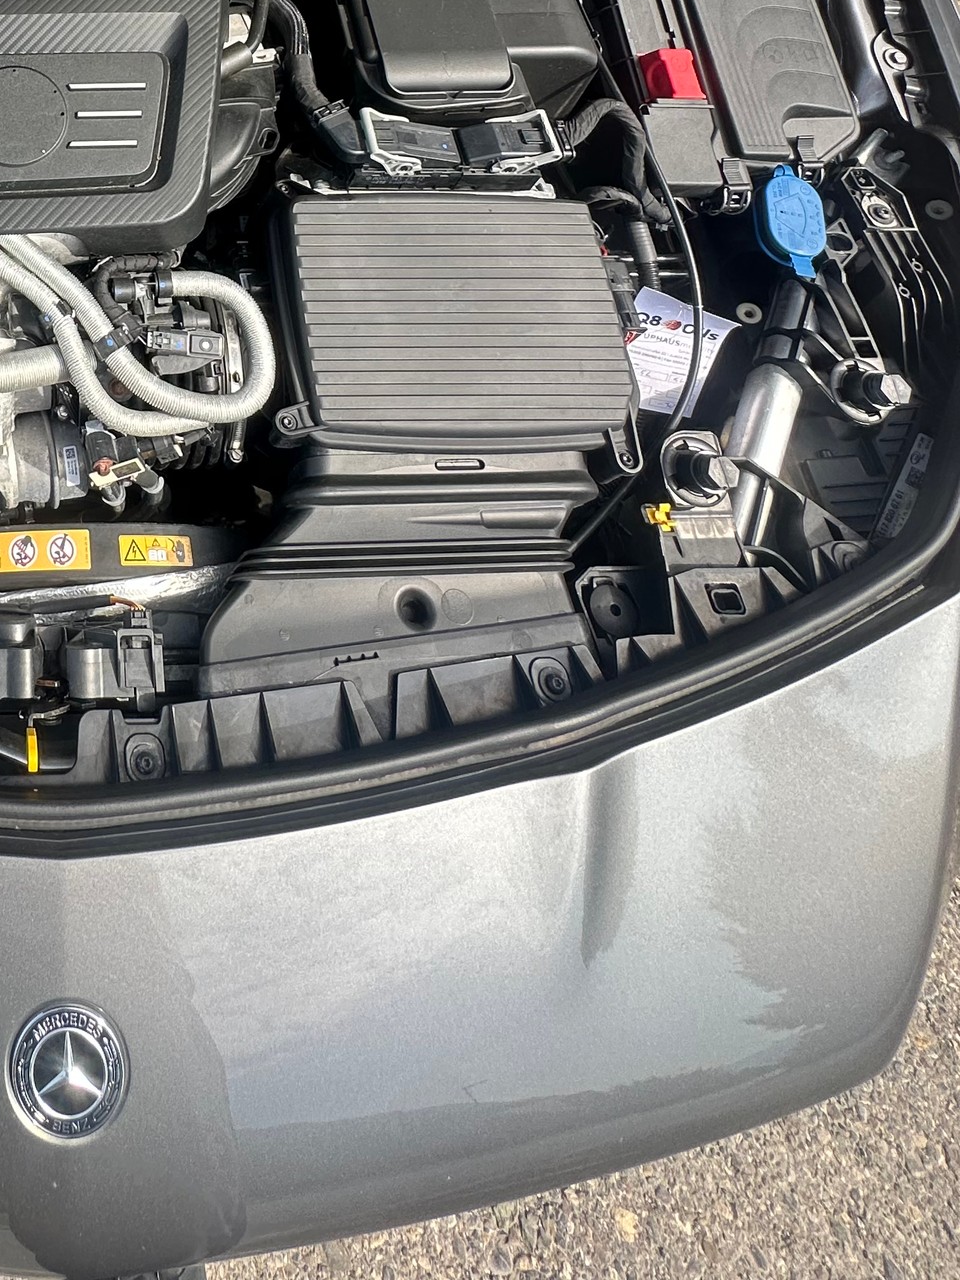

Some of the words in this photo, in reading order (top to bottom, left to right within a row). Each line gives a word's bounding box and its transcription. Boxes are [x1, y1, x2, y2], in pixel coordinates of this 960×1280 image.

[637, 311, 663, 326] Q8
[32, 1012, 105, 1042] MERCEDES
[52, 1116, 91, 1135] BENZ
